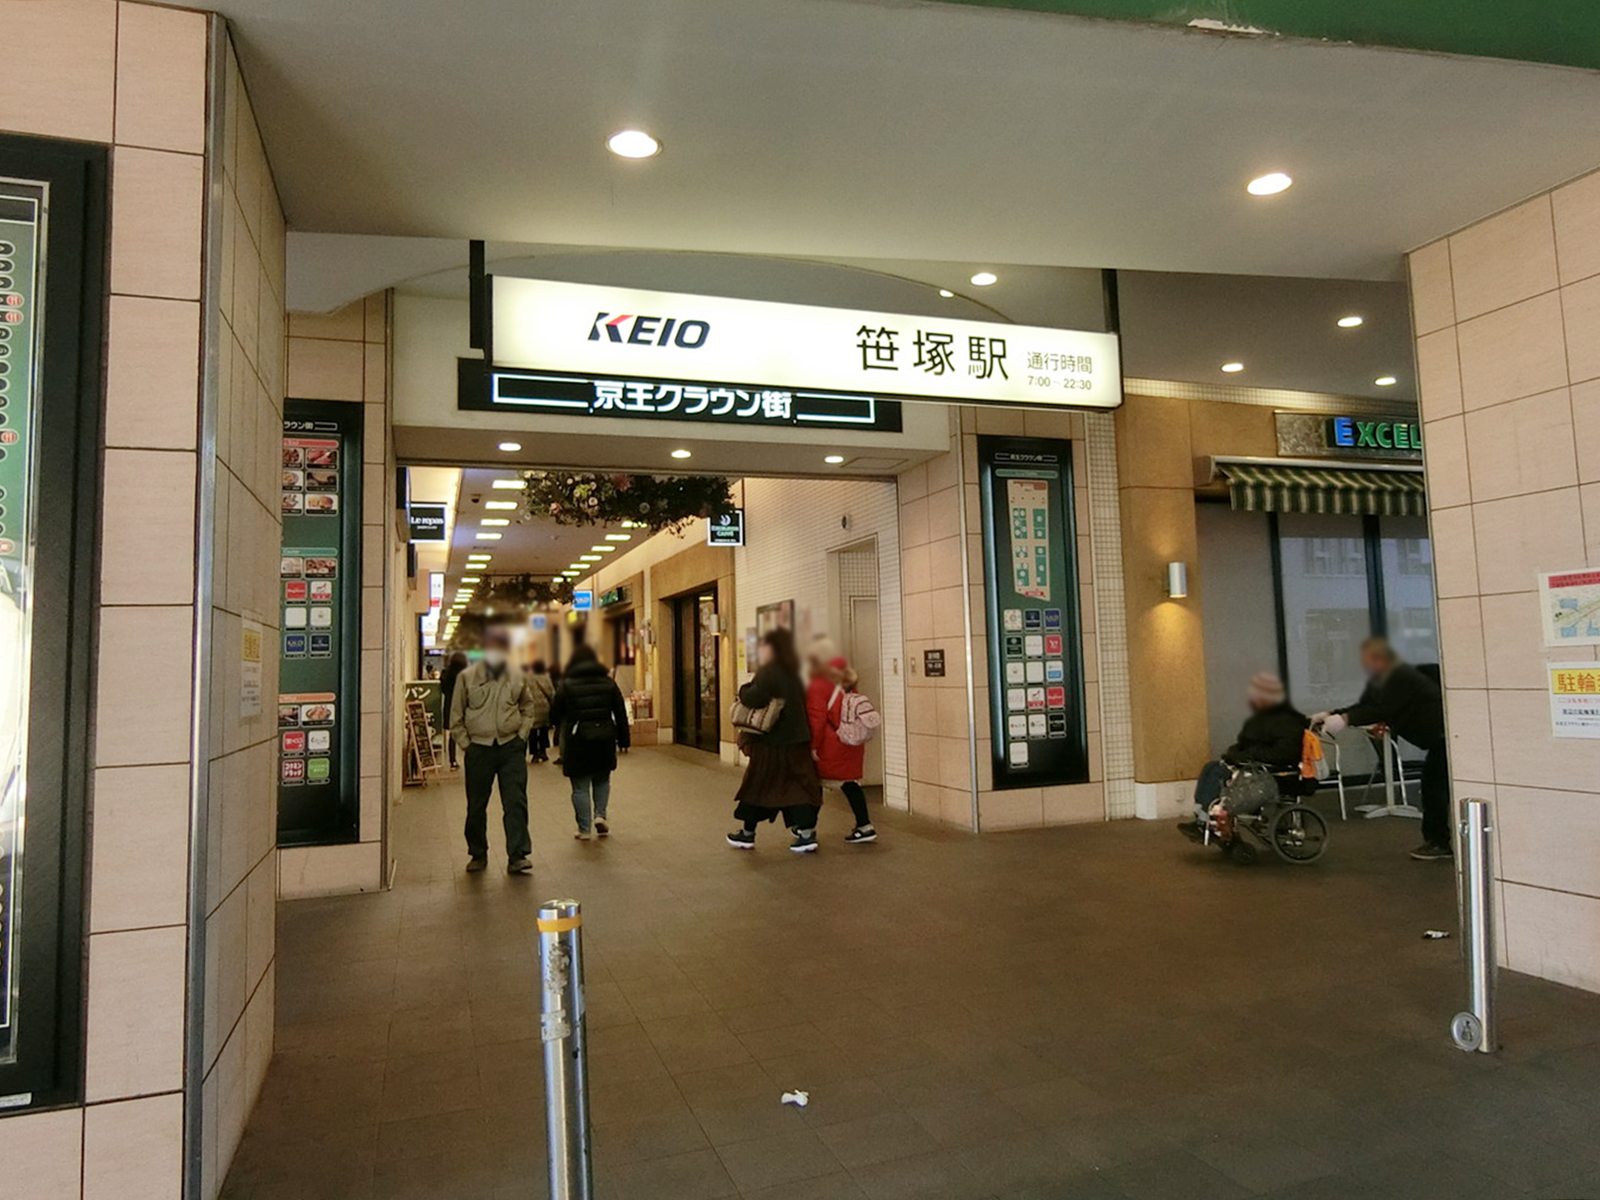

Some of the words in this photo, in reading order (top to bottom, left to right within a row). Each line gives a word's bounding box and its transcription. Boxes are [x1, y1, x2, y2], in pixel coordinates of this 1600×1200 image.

[587, 311, 711, 349] KEIO
[856, 324, 1009, 381] 笹塚駅
[1027, 351, 1093, 374] 通行時間
[593, 380, 792, 419] 京王クラウン街
[1334, 417, 1422, 449] EXCEL
[1557, 672, 1600, 692] 駐輪
